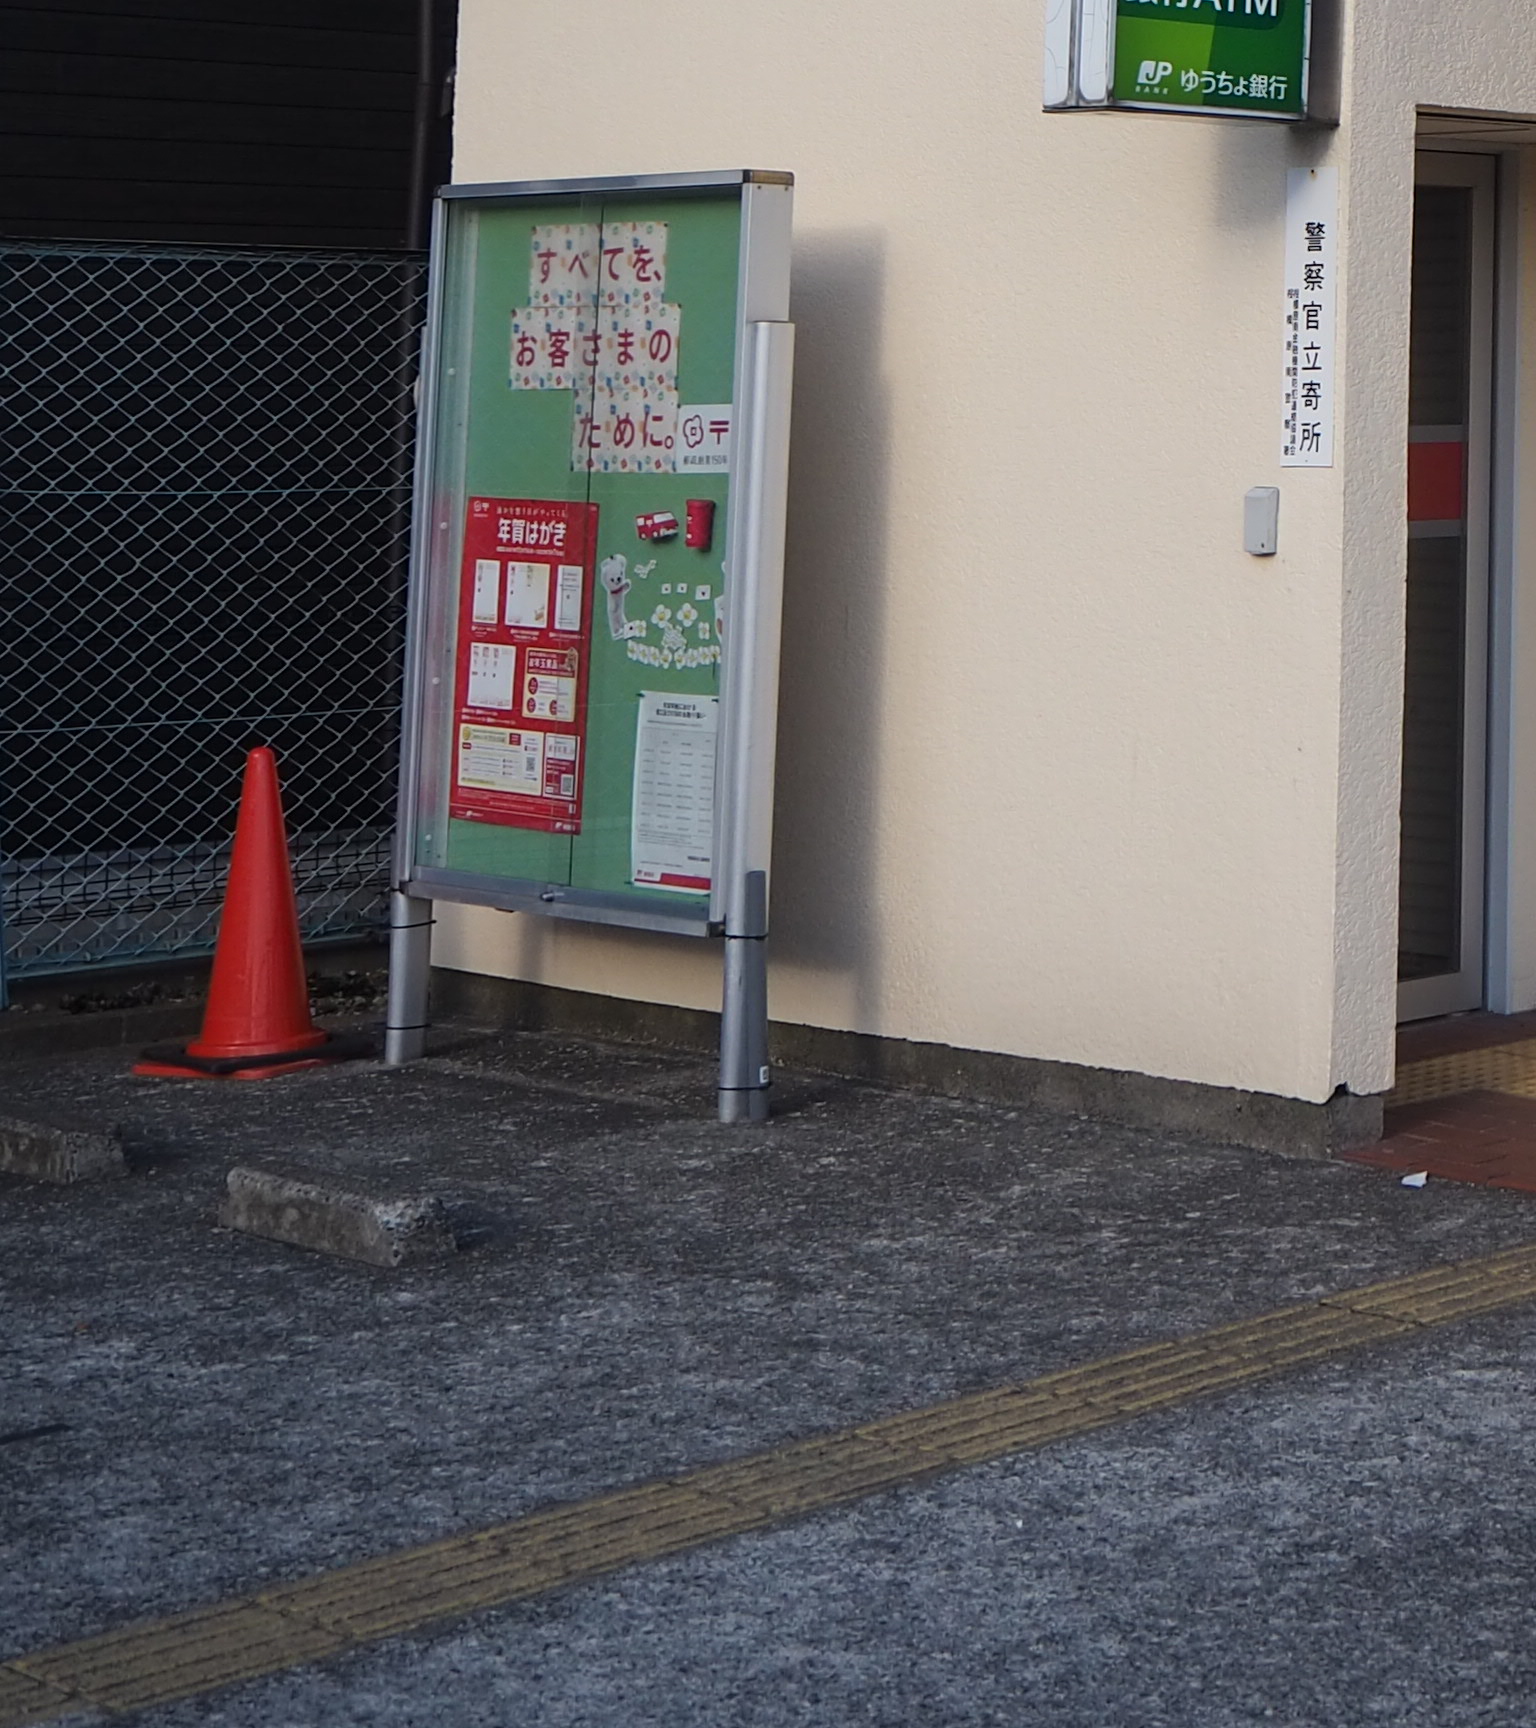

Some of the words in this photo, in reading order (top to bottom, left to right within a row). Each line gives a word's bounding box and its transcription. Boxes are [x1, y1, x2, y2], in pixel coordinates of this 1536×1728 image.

[1180, 68, 1288, 100] ゆうちょ銀行
[537, 245, 662, 284] すべてを、
[516, 328, 672, 368] お客さまの
[1300, 222, 1326, 453] 警察官立寄所
[578, 412, 675, 450] ために。
[497, 517, 567, 547] 年賀はがき
